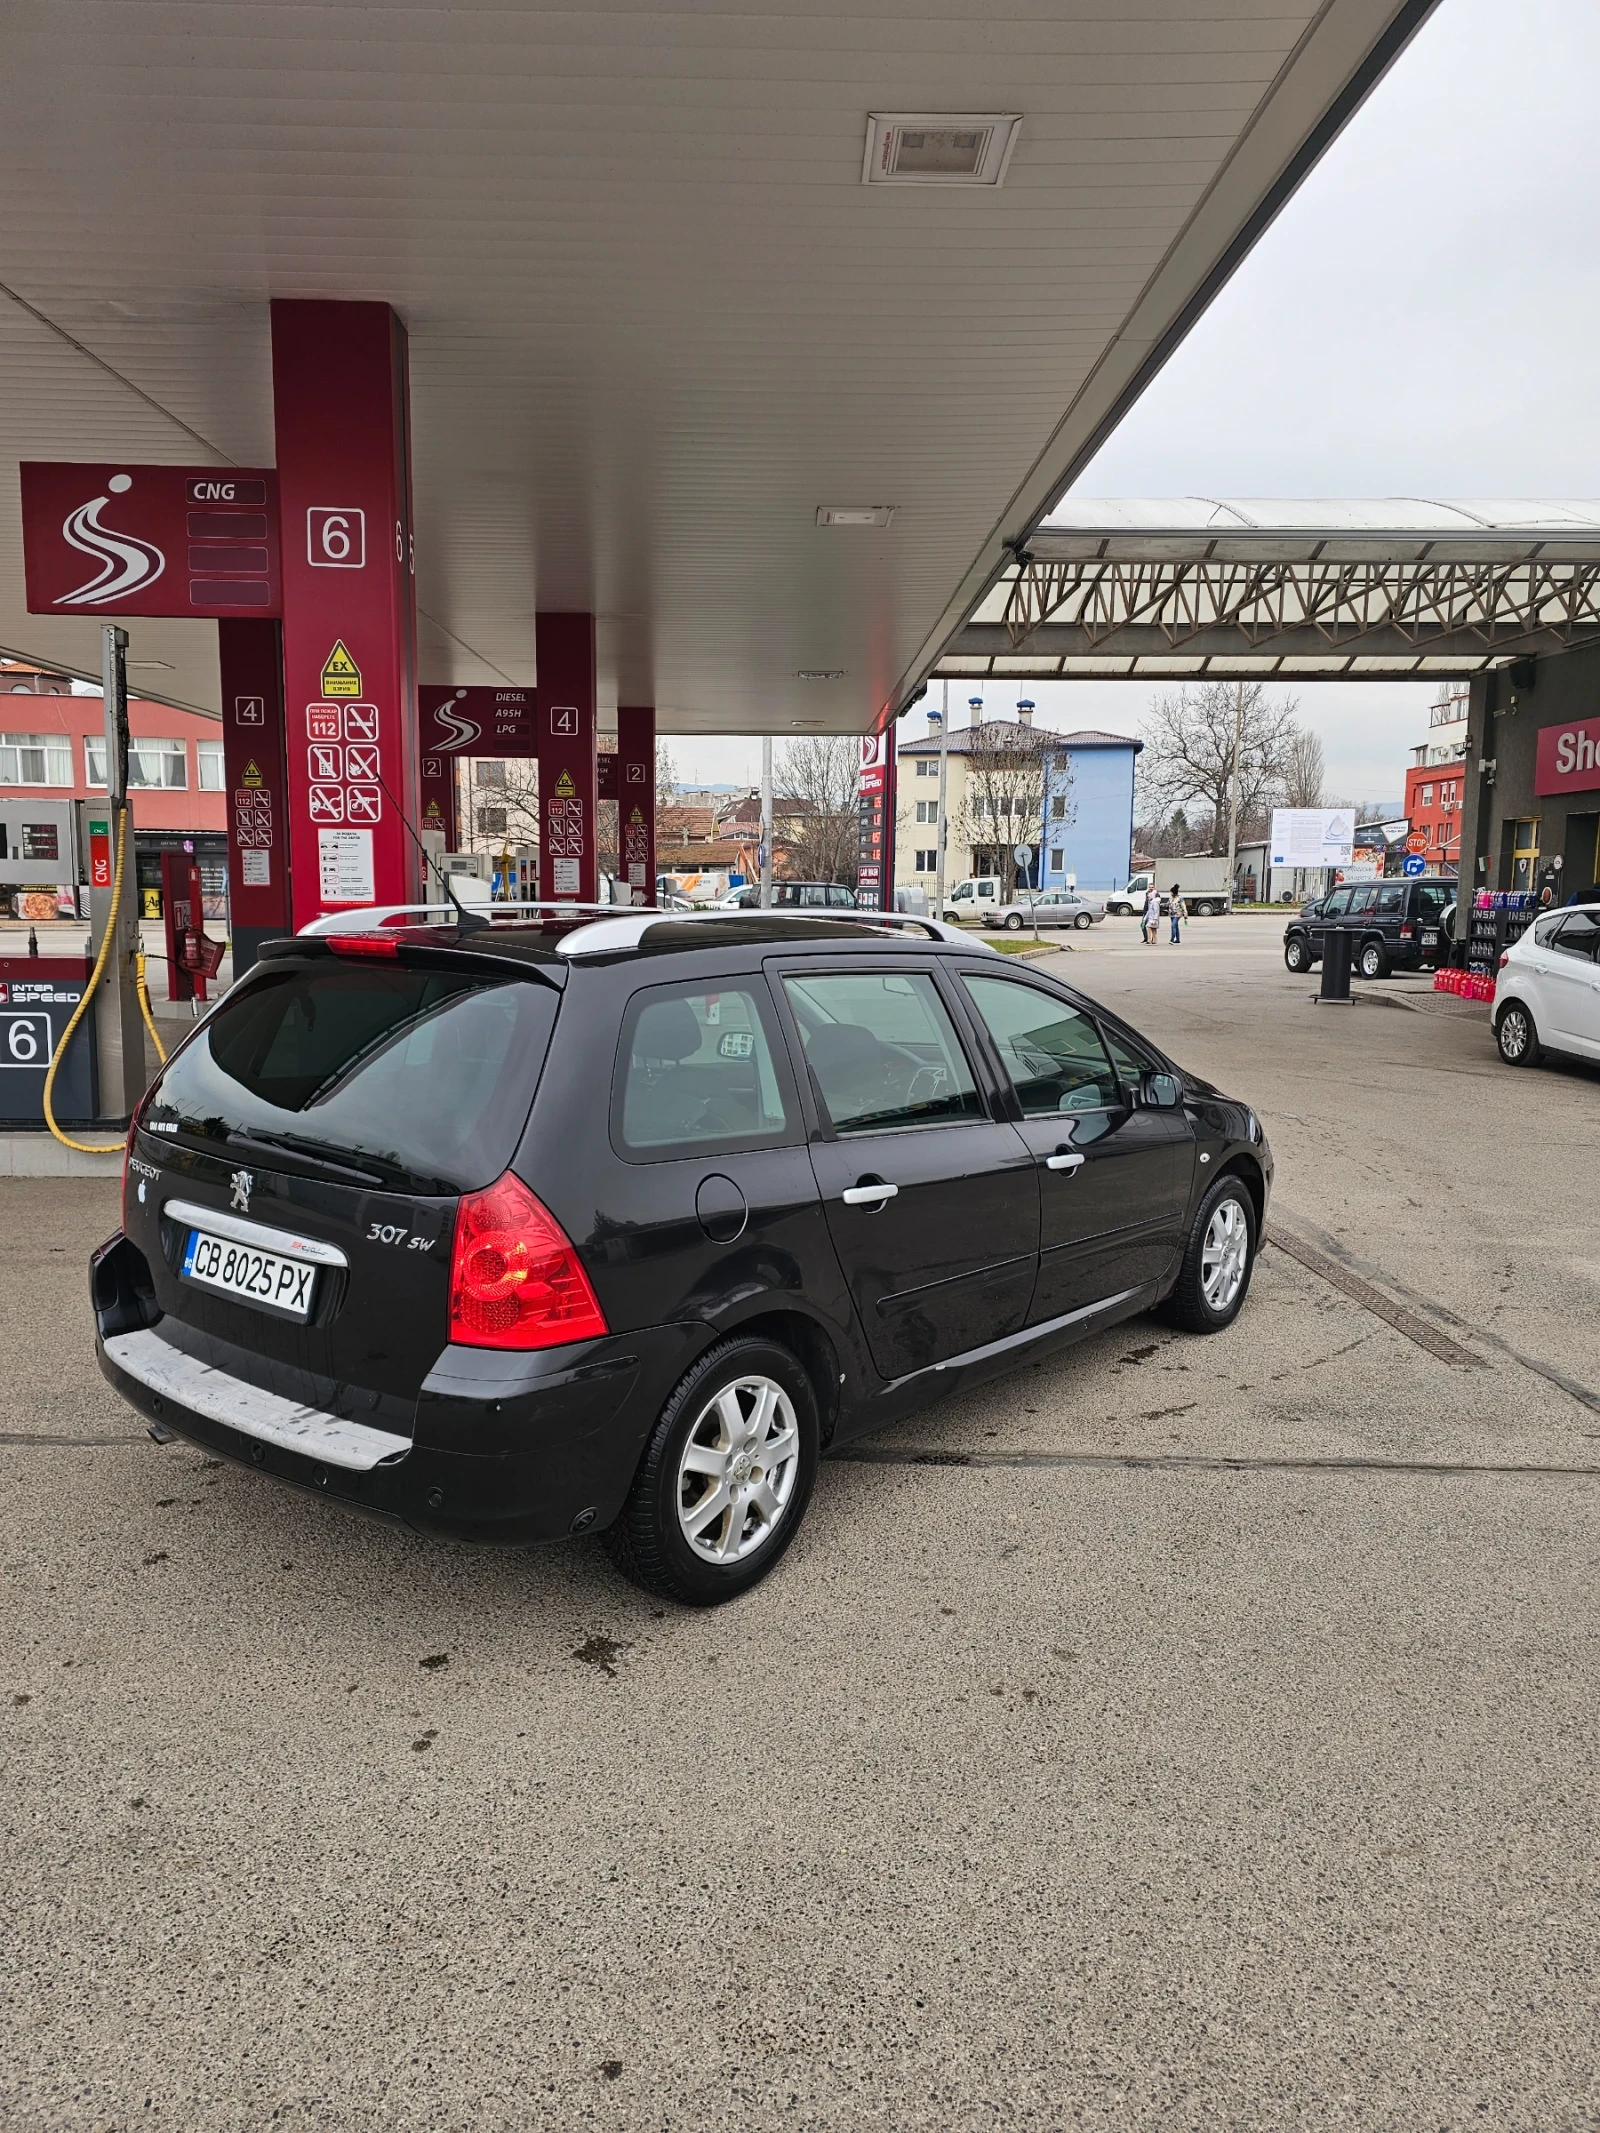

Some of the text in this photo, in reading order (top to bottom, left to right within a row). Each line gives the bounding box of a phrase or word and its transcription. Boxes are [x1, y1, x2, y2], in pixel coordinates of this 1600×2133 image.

[193, 483, 235, 500] CNG
[322, 516, 350, 558] 6
[395, 520, 403, 562] 6
[332, 661, 348, 671] EX
[496, 692, 526, 701] DIESEL
[242, 700, 257, 721] 4
[495, 708, 522, 717] A95H
[312, 722, 336, 735] 112
[496, 724, 516, 733] LPG
[557, 711, 572, 732] 4
[427, 761, 437, 775] 2
[631, 766, 641, 780] 2
[1408, 838, 1426, 847] STOP
[95, 859, 107, 882] CNG
[12, 984, 53, 992] INTER
[12, 993, 80, 1002] SPEED
[9, 1020, 37, 1060] 6
[129, 1157, 162, 1180] PEUGEOT
[366, 1223, 436, 1251] 307 SW
[195, 1240, 311, 1308] CB 8025 PX
